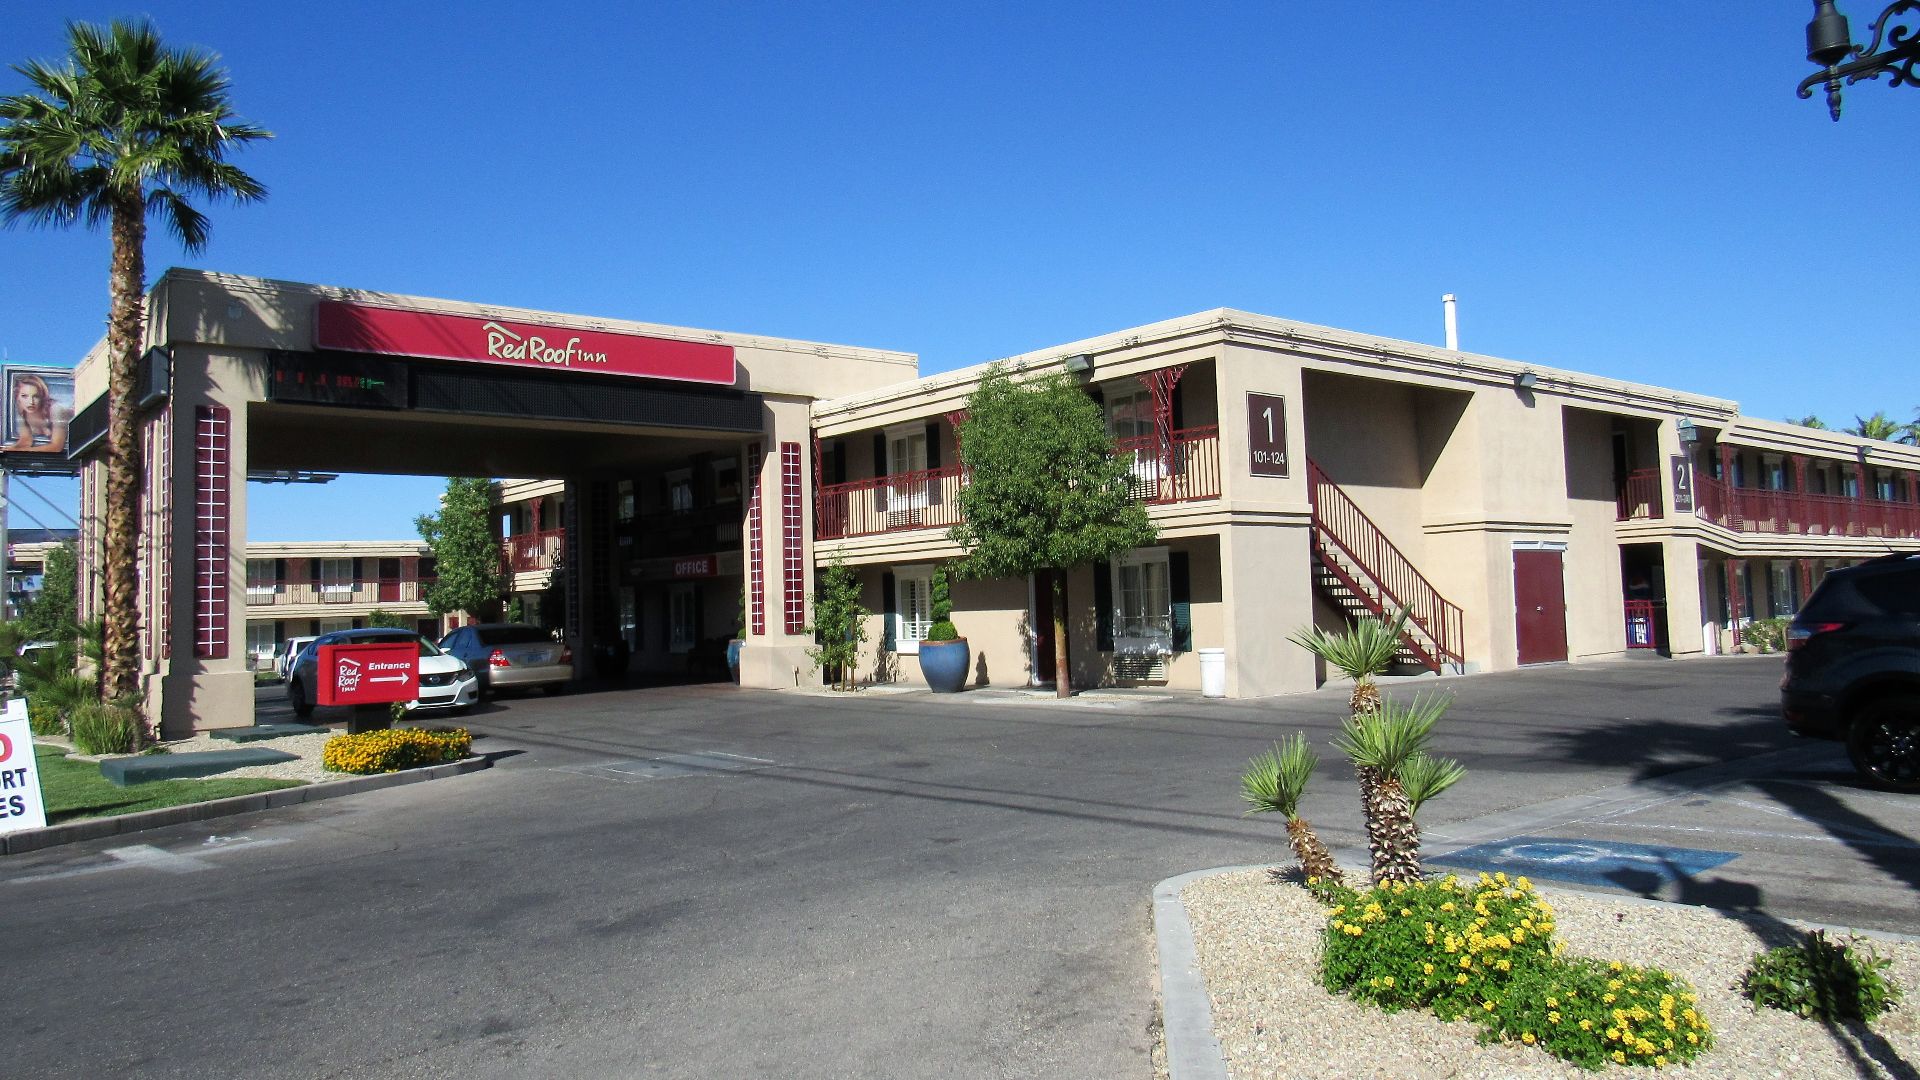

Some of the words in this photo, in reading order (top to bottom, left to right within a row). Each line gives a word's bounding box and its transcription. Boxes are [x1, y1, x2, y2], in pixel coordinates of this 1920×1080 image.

[488, 332, 528, 360] Red
[529, 336, 580, 366] Roof
[1262, 407, 1273, 443] 1
[1253, 450, 1285, 465] 101-124
[1677, 464, 1686, 490] 2
[675, 560, 708, 575] OFFICE
[339, 665, 358, 676] Red
[368, 662, 411, 671] Entrance
[338, 674, 362, 688] Roof
[0, 767, 27, 790] RT
